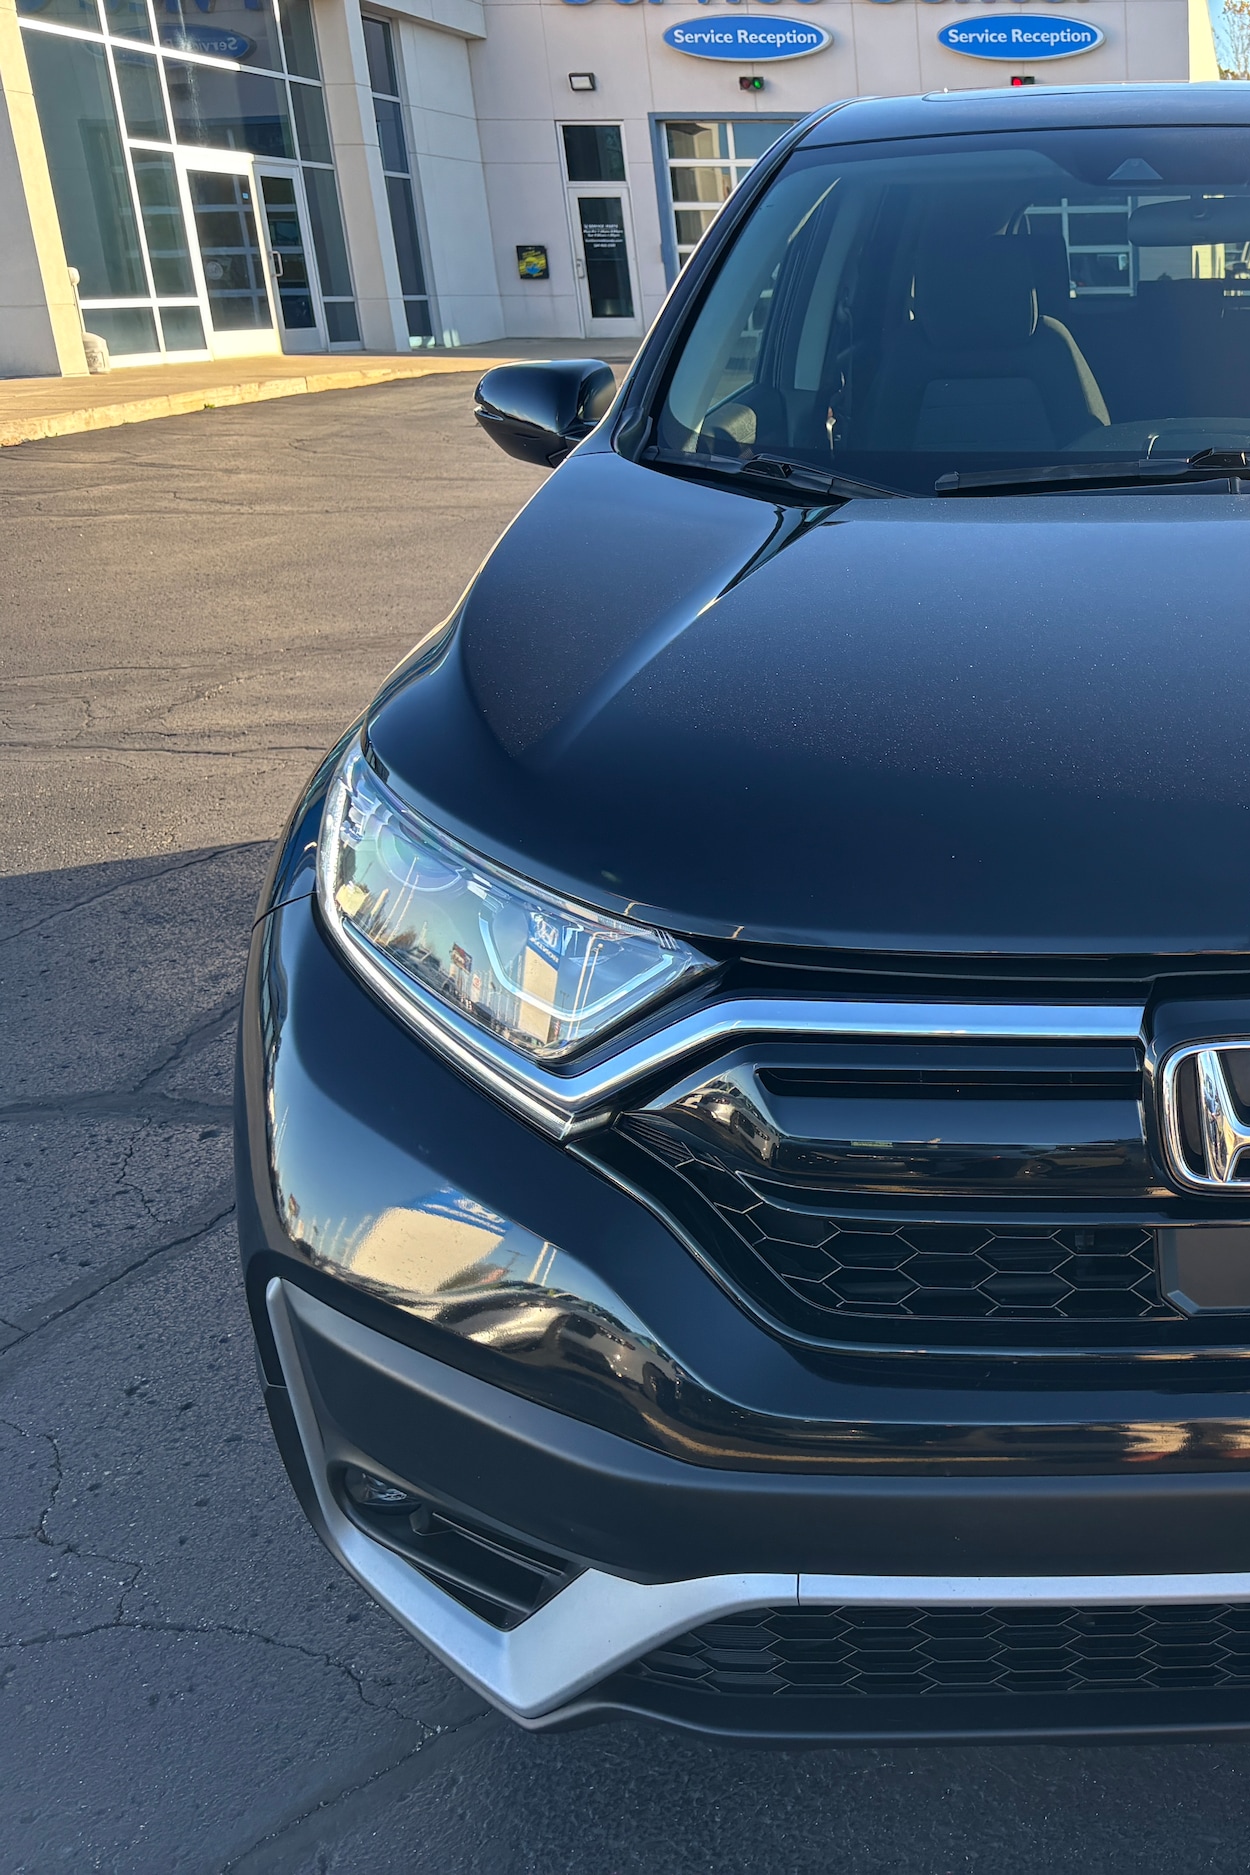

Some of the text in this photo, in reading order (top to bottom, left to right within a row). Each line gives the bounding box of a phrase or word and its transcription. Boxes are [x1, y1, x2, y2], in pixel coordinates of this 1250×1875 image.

[673, 29, 818, 48] Service Reception
[948, 28, 1092, 46] Service Reception
